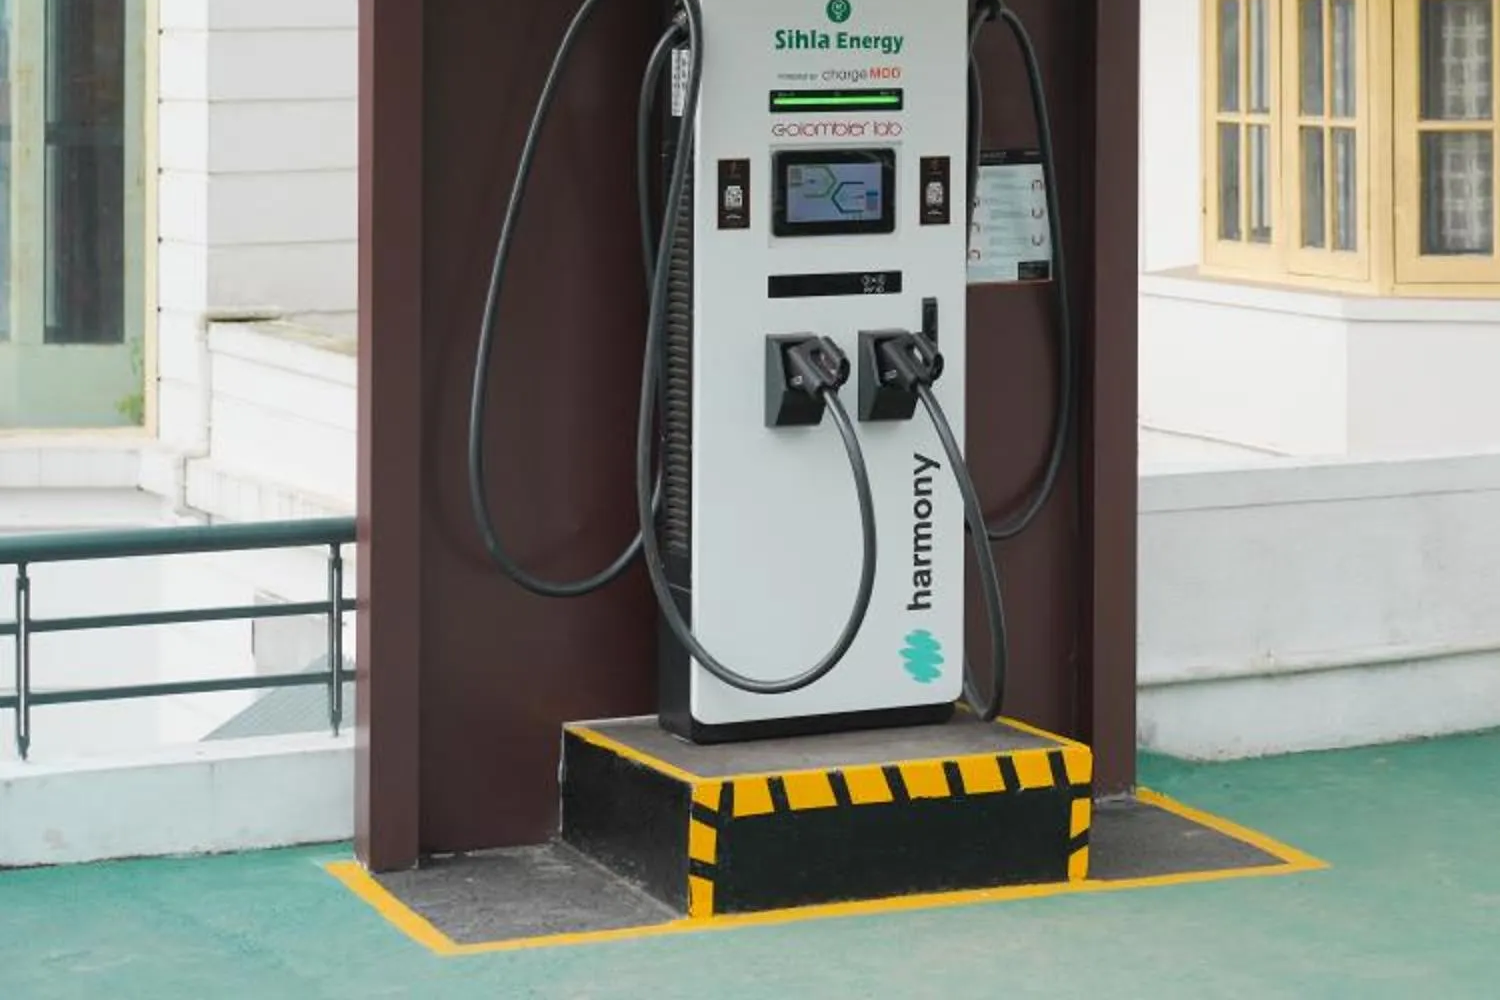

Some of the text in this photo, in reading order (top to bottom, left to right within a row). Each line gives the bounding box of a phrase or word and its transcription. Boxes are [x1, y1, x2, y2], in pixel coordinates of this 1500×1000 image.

[775, 30, 904, 55] Sihla Energy
[906, 452, 941, 611] harmony
